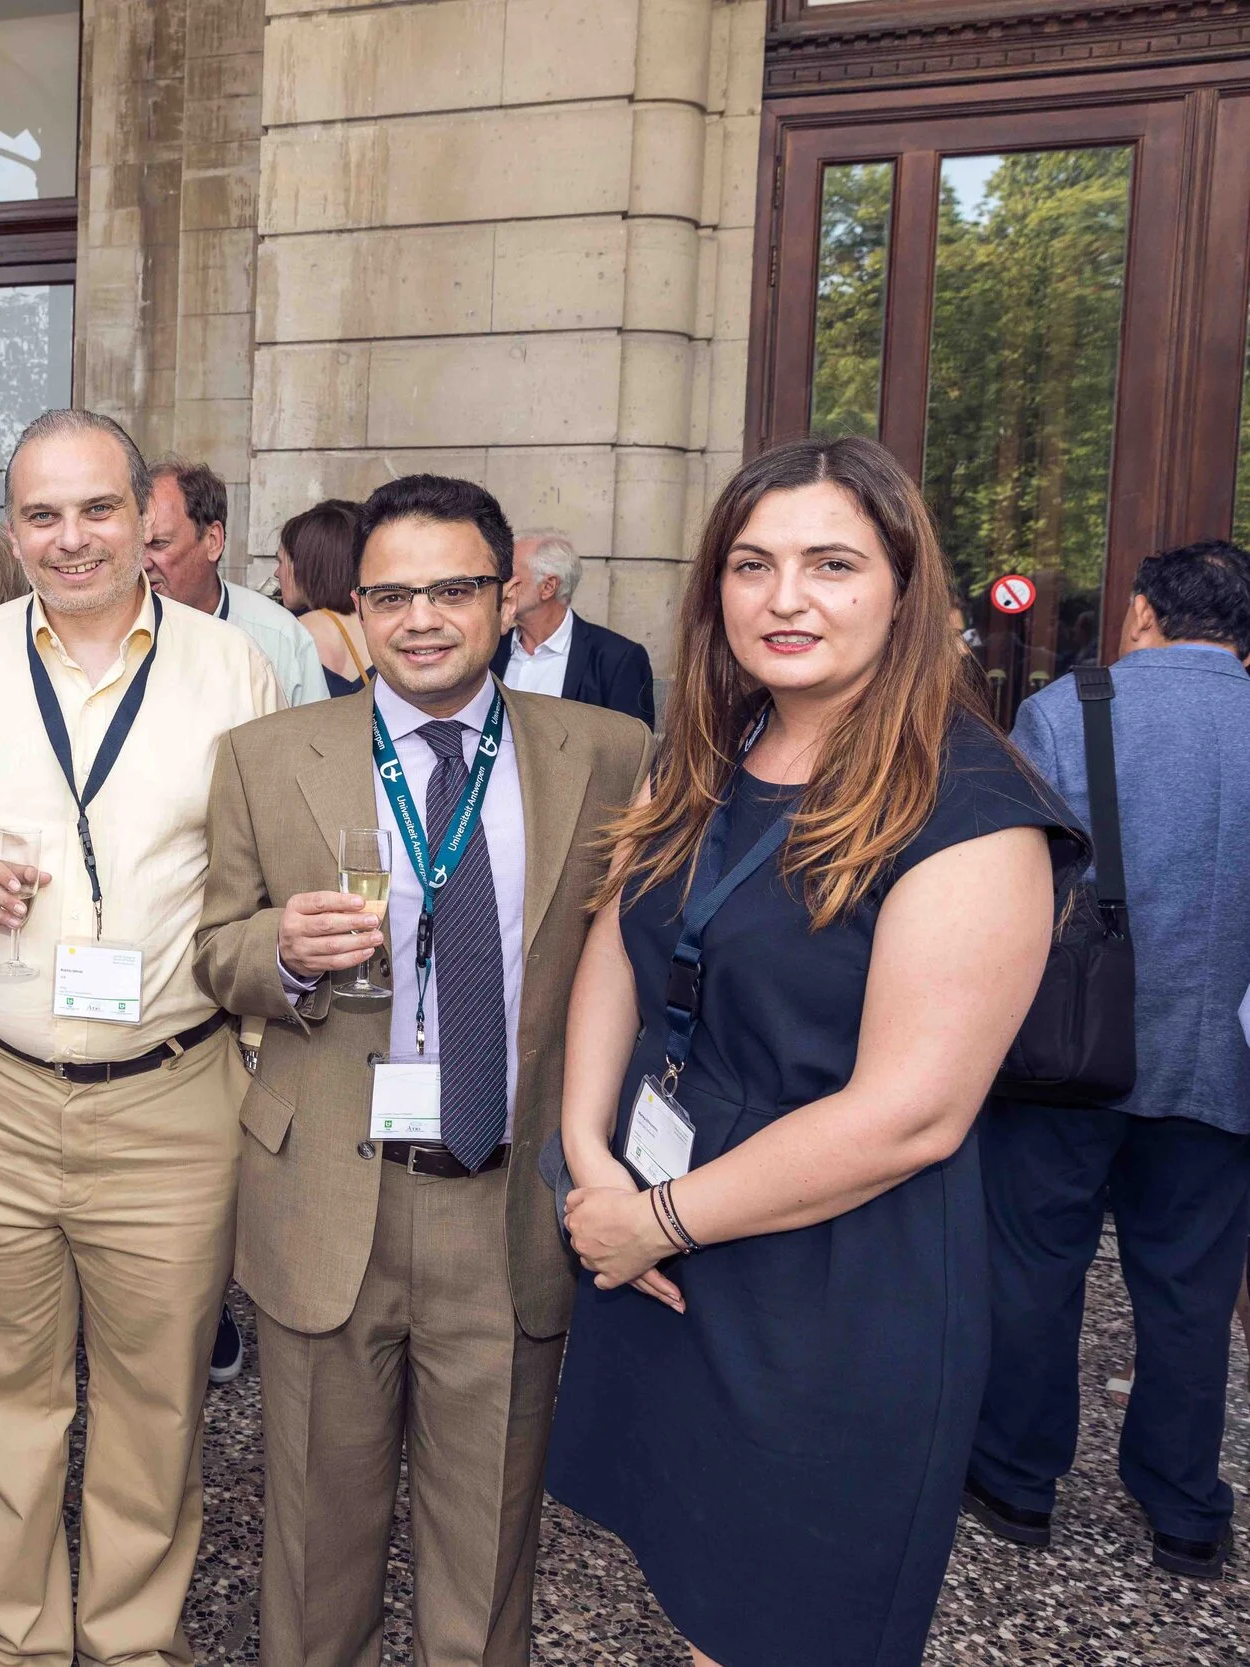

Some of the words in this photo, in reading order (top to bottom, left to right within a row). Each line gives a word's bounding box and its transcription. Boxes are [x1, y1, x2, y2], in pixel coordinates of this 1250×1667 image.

[396, 795, 418, 840] Universiteit
[448, 805, 473, 852] Universiteit
[468, 766, 485, 807] Antwerpen
